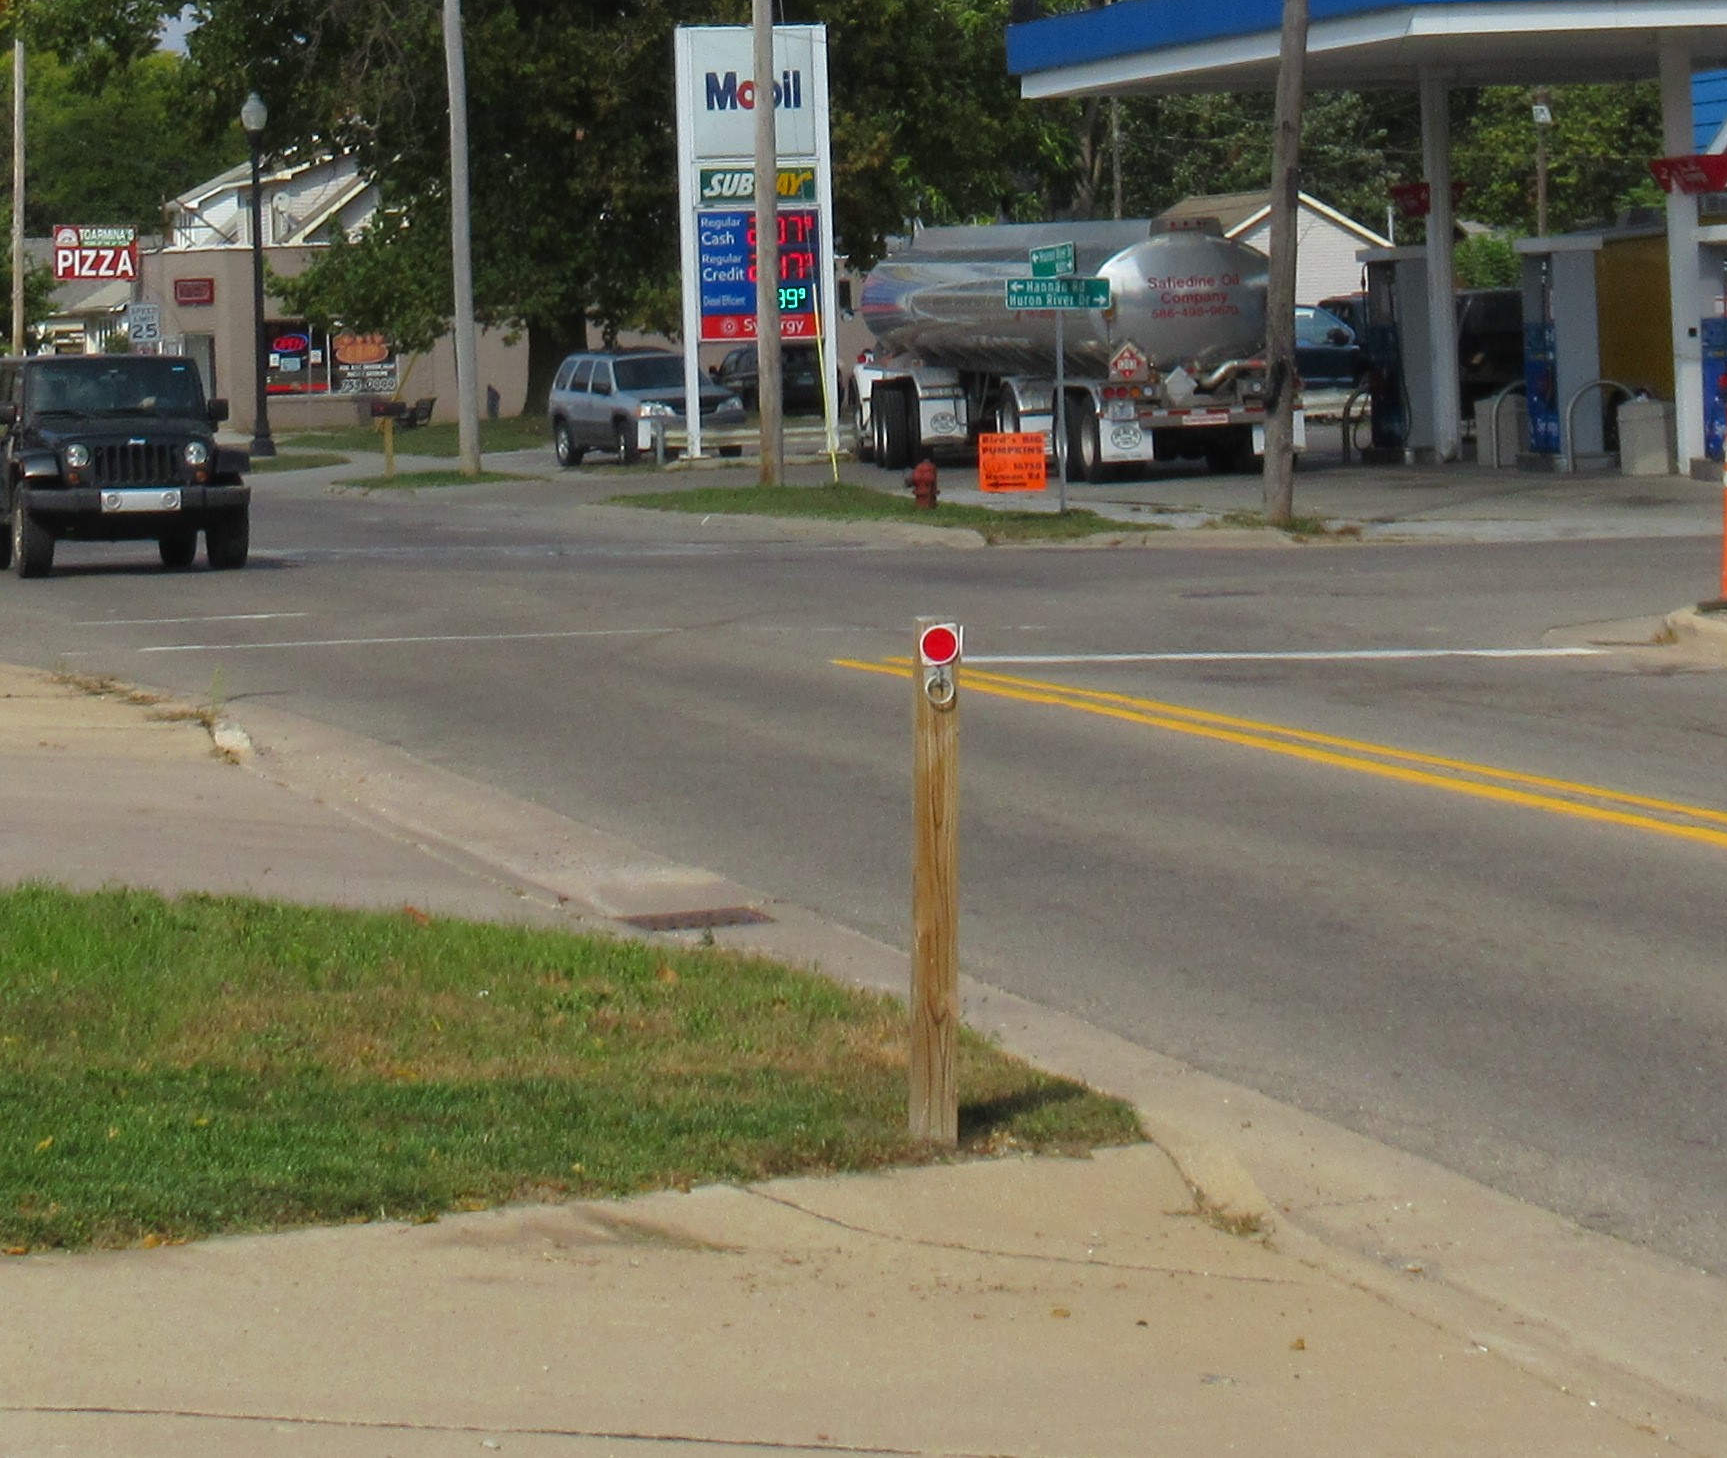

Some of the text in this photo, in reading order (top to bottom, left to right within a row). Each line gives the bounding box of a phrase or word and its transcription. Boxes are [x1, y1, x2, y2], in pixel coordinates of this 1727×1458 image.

[703, 172, 812, 198] SUBAY
[700, 217, 741, 230] Regular
[701, 231, 735, 245] Cash
[57, 250, 135, 277] PIZZA
[702, 253, 743, 266] Regular
[703, 265, 745, 282] Credit
[1221, 273, 1240, 286] Oil
[1026, 281, 1085, 293] Hannan Rd
[1009, 293, 1090, 306] Huron River Dr
[1161, 292, 1229, 305] Company
[132, 324, 159, 339] 25
[743, 318, 805, 334] Srgy
